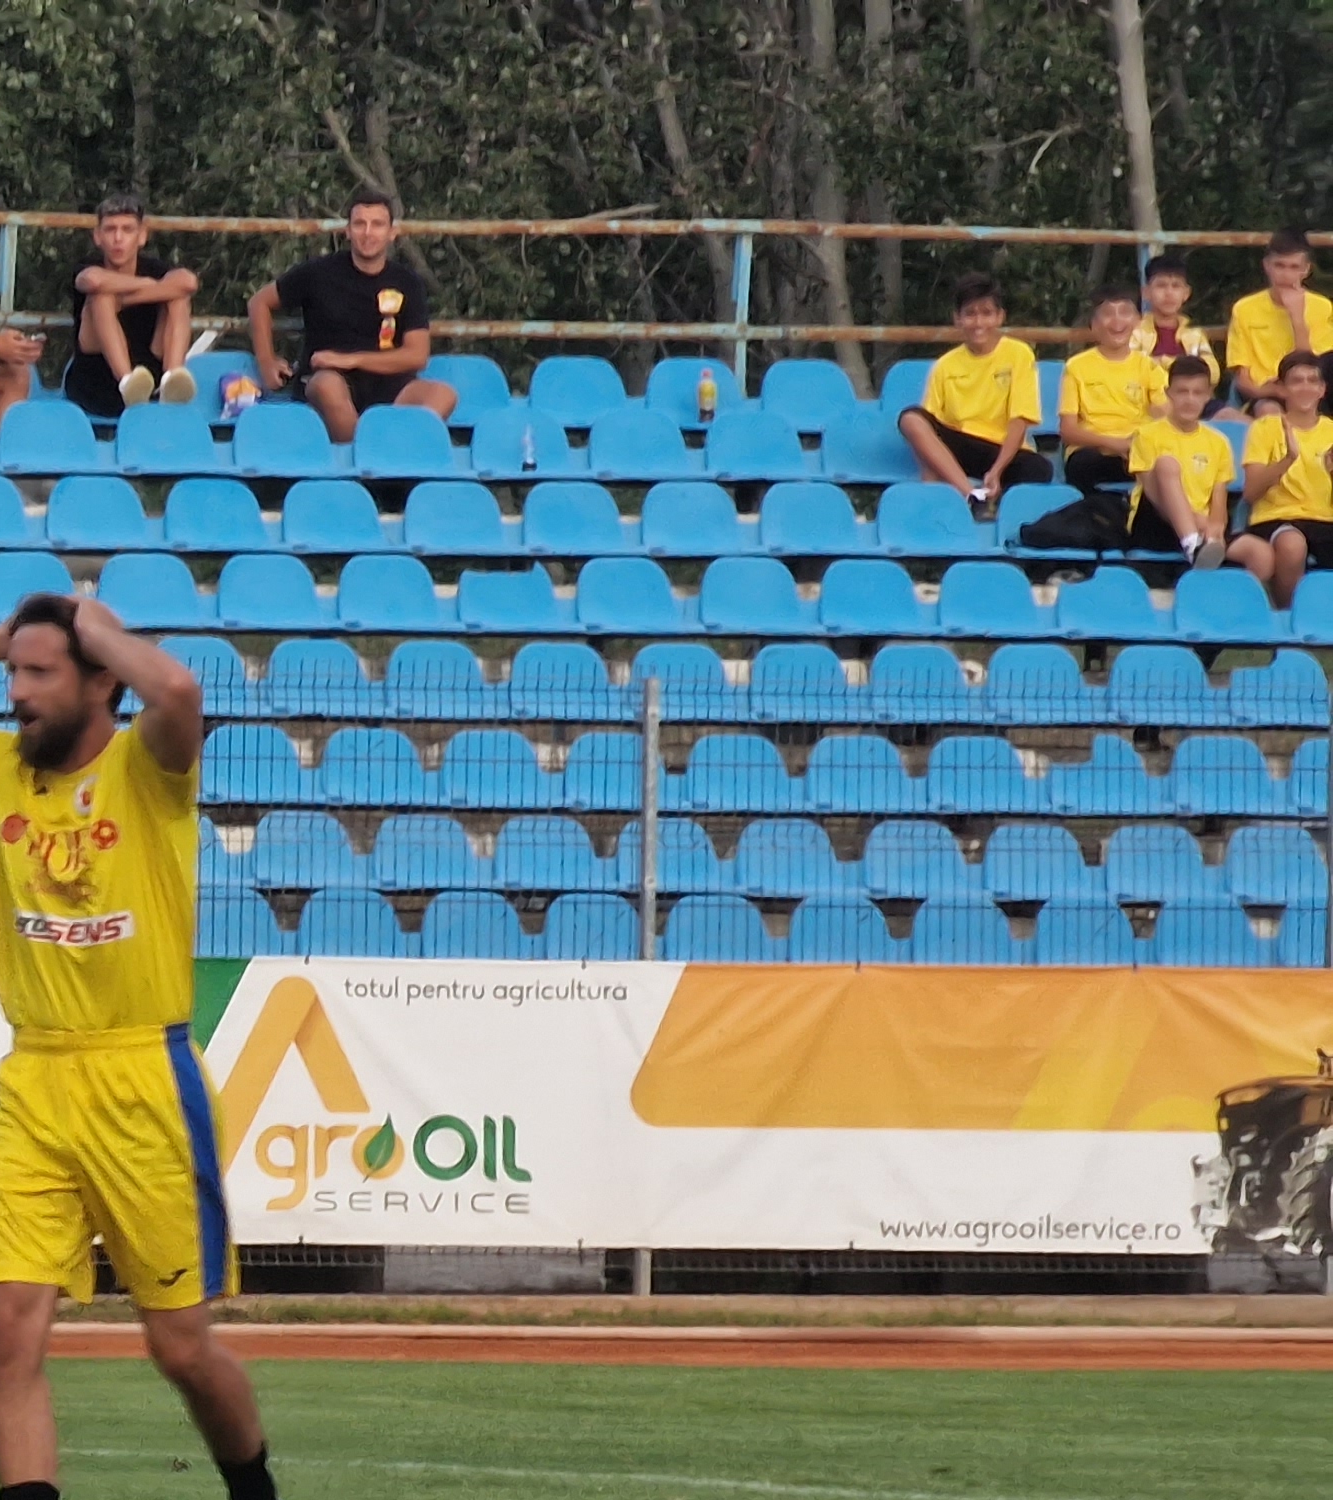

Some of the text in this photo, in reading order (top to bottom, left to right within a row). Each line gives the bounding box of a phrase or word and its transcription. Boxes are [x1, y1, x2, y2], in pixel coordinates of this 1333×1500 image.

[344, 976, 628, 1007] totul pentru agricultura
[313, 1190, 531, 1215] SERVICE
[879, 1213, 1182, 1247] www.agrooilservice.ro
